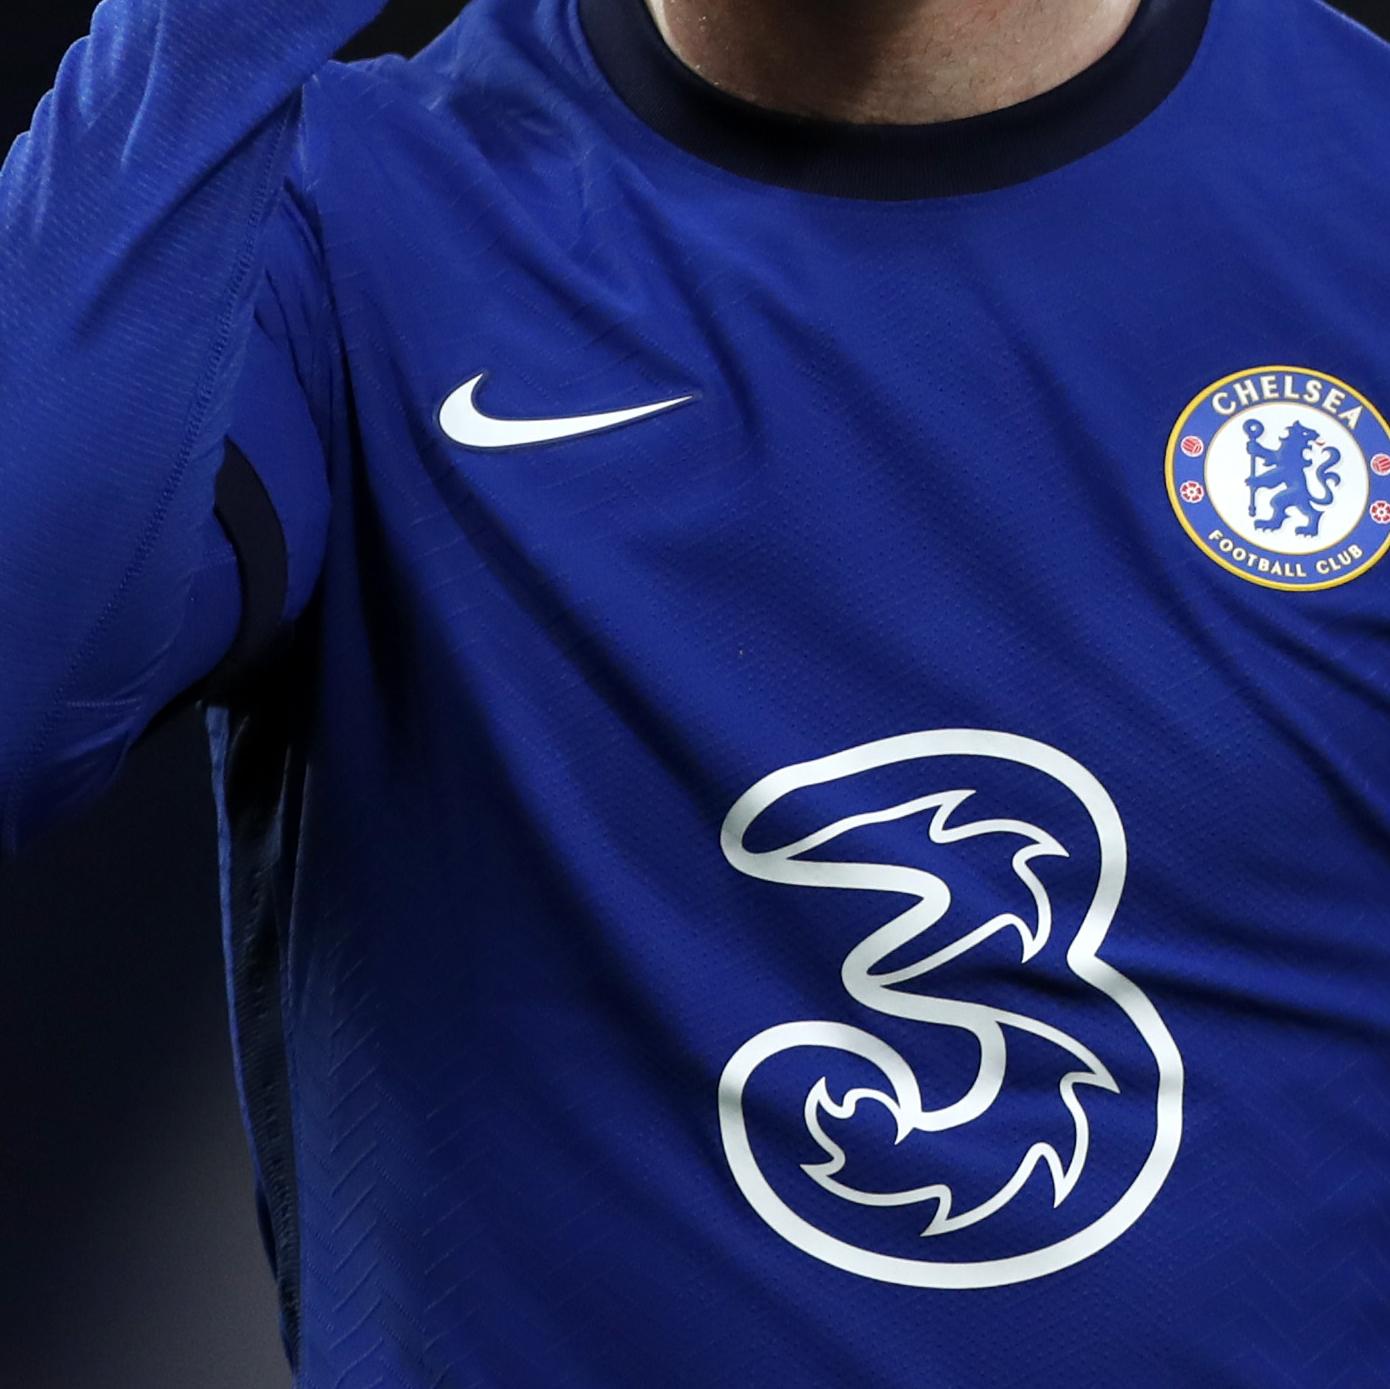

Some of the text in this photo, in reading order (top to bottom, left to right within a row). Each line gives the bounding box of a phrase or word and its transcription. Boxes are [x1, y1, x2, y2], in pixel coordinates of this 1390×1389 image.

[1211, 374, 1364, 430] CHELSEA
[1208, 529, 1364, 578] FOOTBALL CLUB
[717, 727, 1185, 1290] 3
